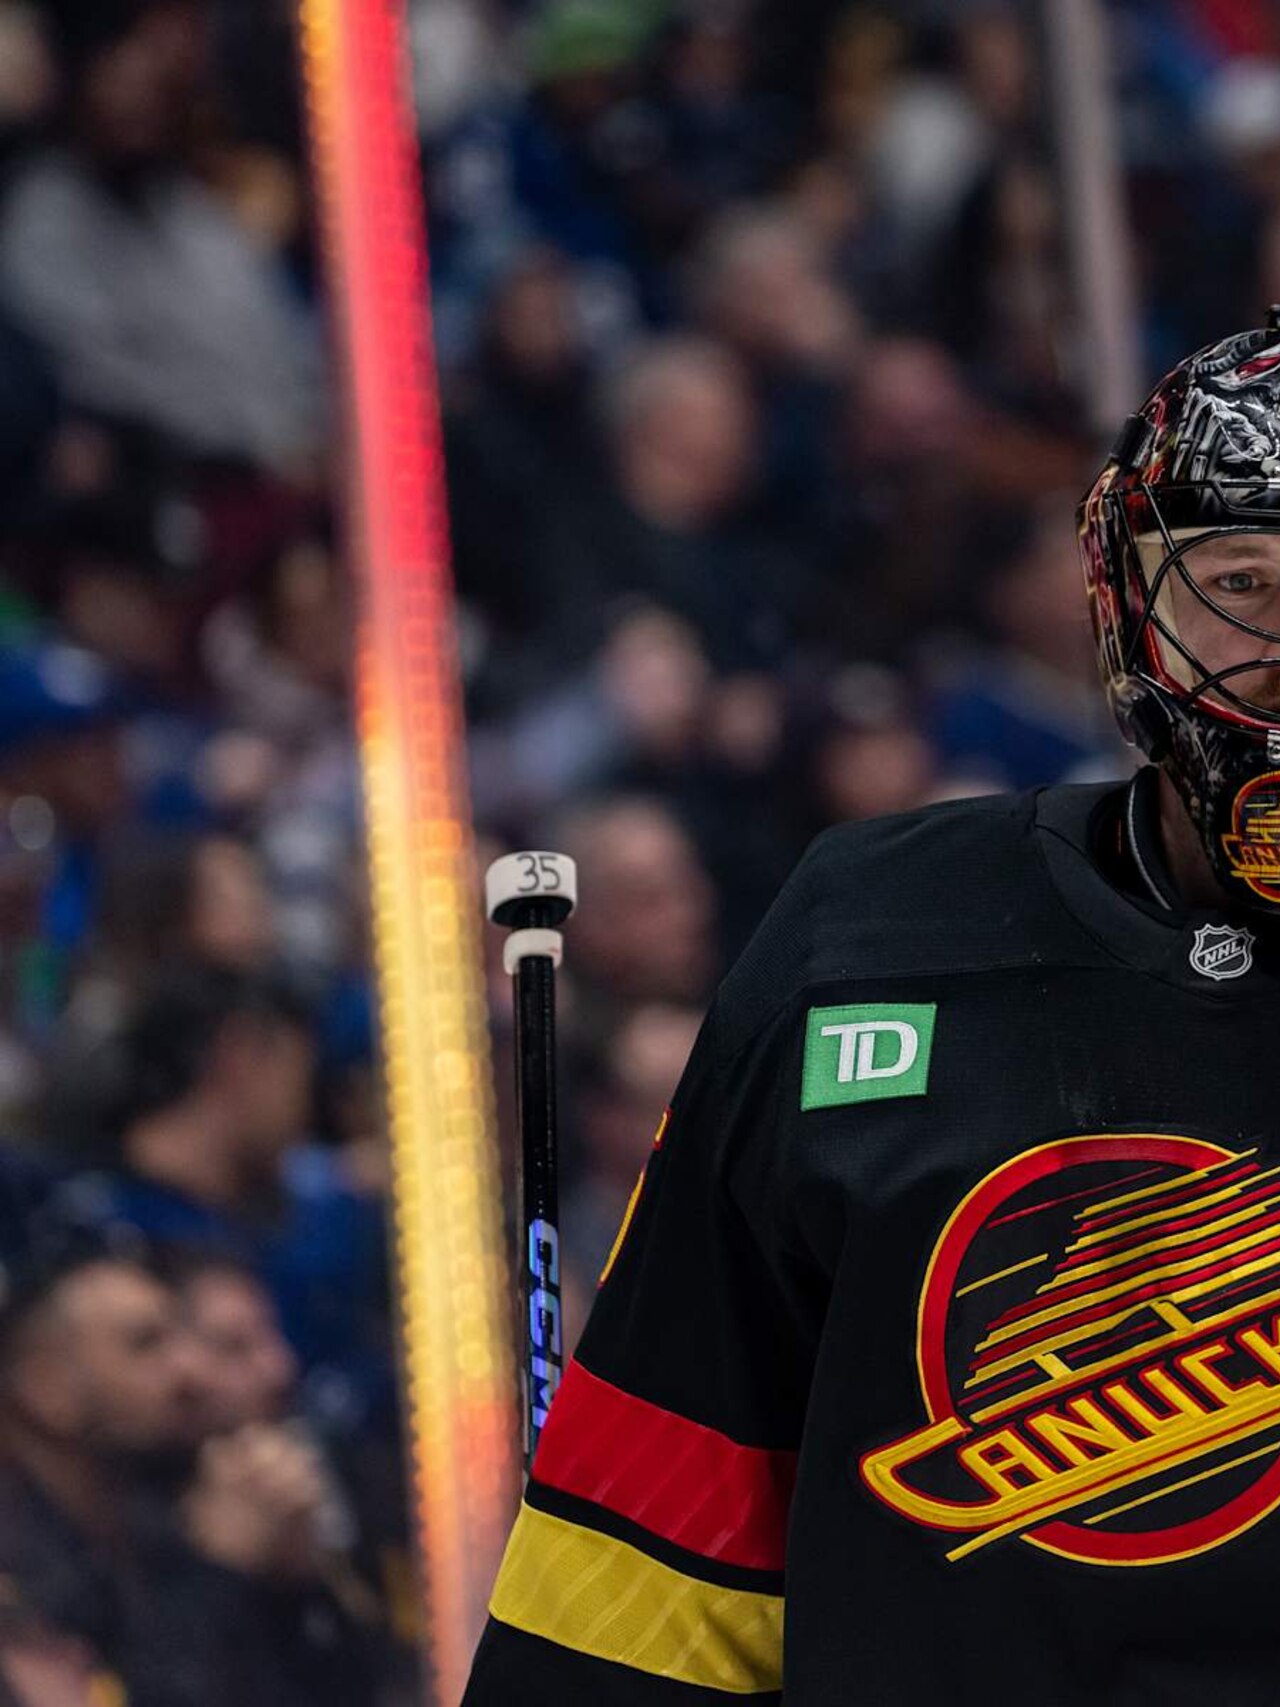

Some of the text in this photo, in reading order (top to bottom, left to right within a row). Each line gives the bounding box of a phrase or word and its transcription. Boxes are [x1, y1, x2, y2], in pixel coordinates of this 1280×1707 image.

[517, 854, 560, 892] 35
[1204, 941, 1242, 967] NHL
[821, 1021, 918, 1083] TD
[529, 1218, 562, 1428] CCM
